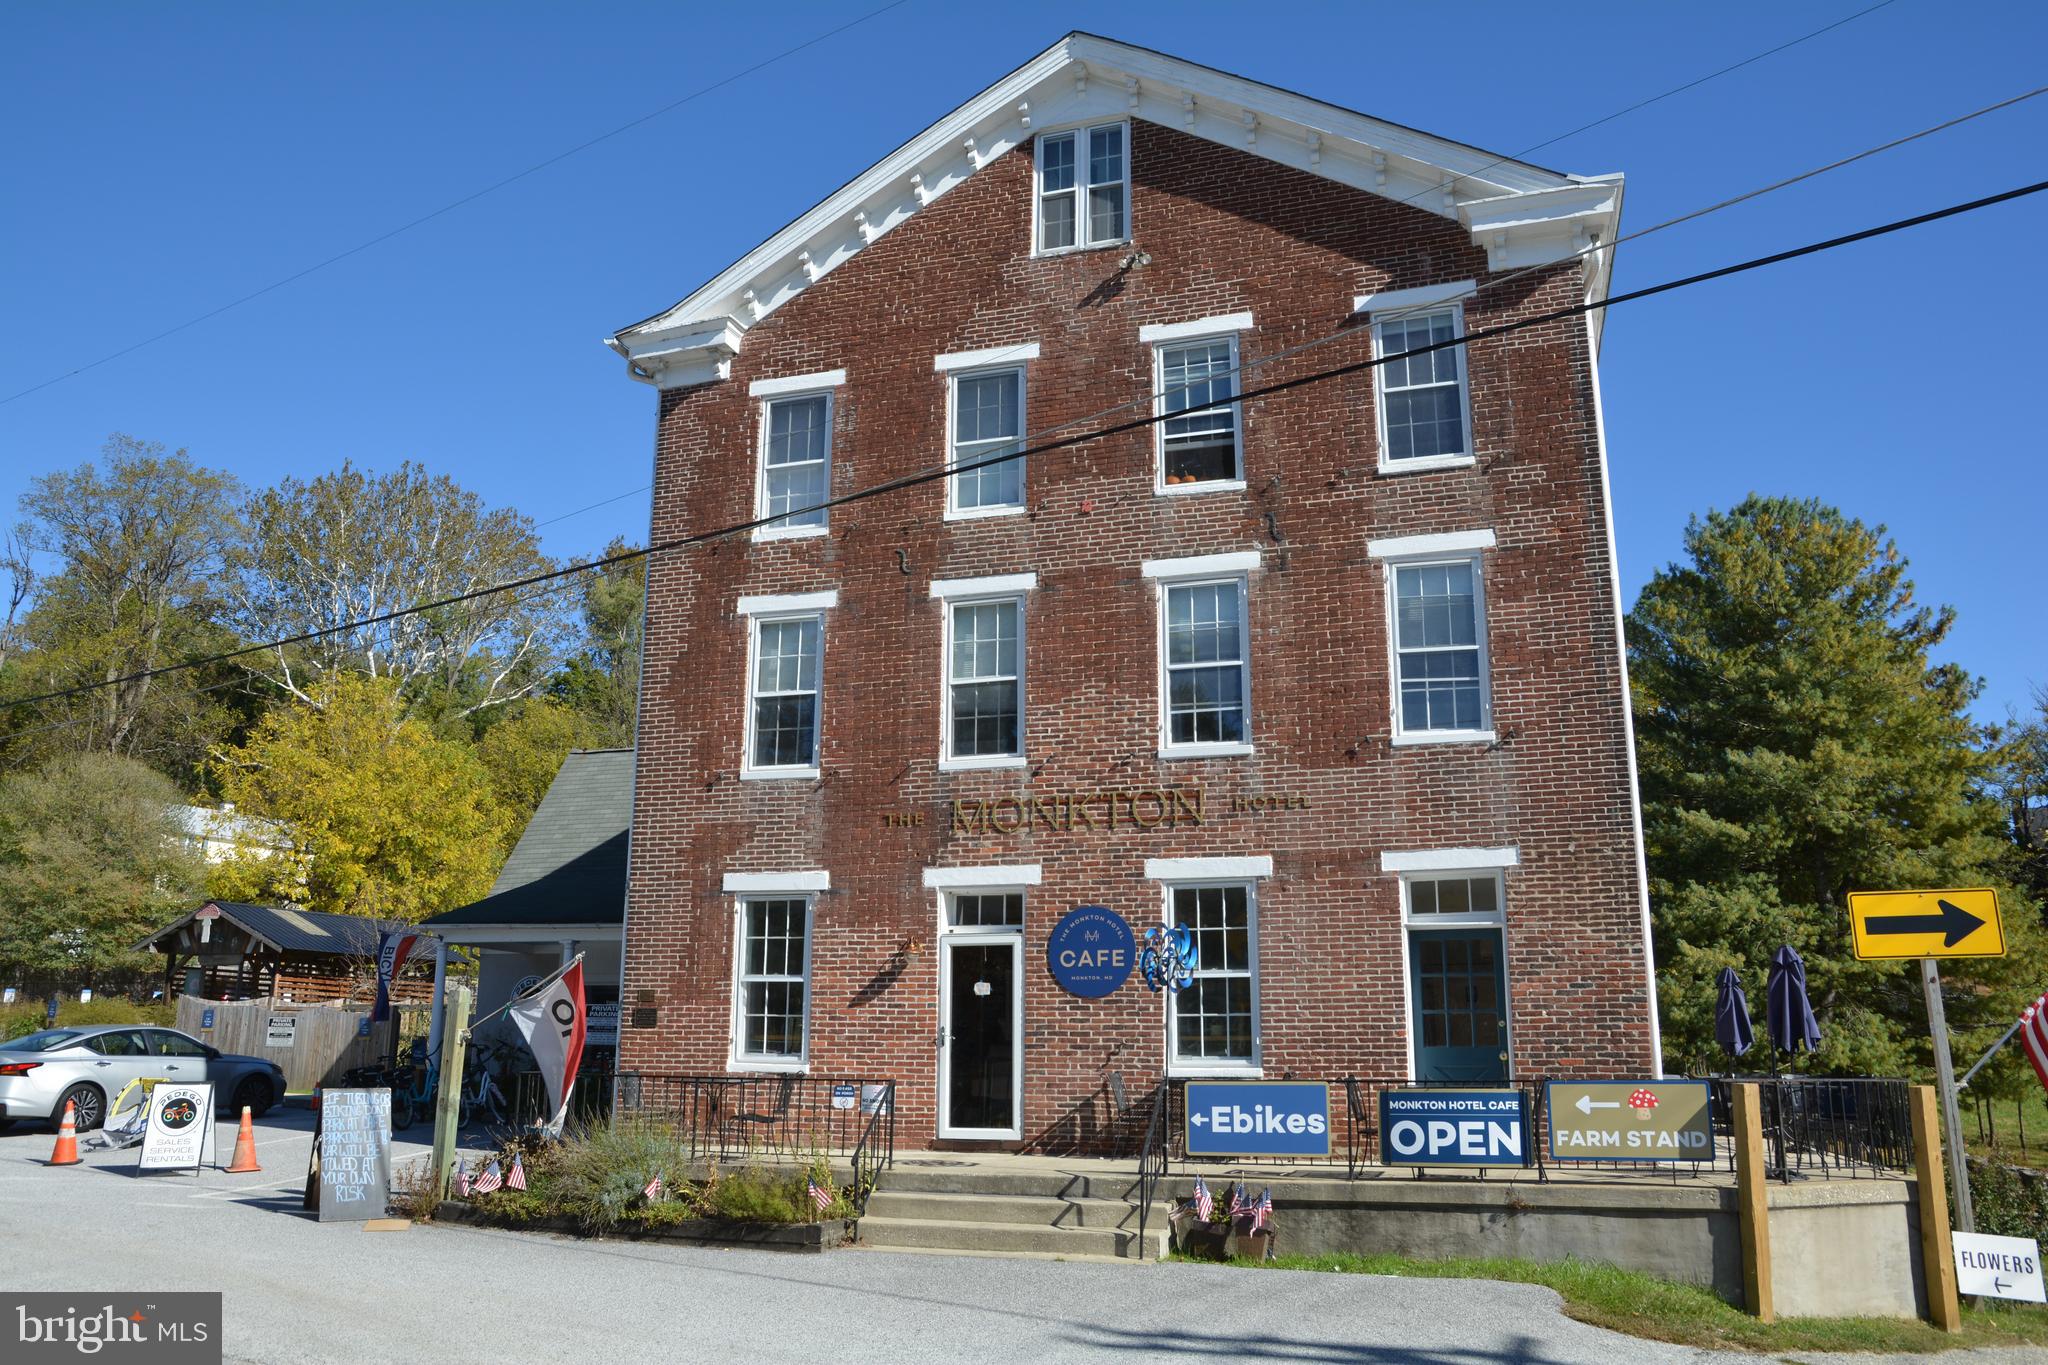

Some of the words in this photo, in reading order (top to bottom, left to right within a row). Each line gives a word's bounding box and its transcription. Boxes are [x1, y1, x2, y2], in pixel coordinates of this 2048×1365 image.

[884, 811, 925, 829] THE
[951, 786, 1206, 836] MONKTON
[1232, 795, 1314, 812] HOTEL
[1060, 928, 1070, 942] THE
[1069, 914, 1105, 929] MONKTON
[1106, 919, 1125, 940] HOTEL
[1059, 949, 1126, 968] CAFE
[160, 1091, 202, 1107] PEDEGO
[323, 1092, 342, 1105] IF
[344, 1092, 379, 1106] TUBING
[380, 1093, 391, 1106] OR
[1389, 1100, 1446, 1110] MONKTON
[1449, 1101, 1486, 1110] HOTEL
[1488, 1101, 1519, 1110] CAFE
[322, 1105, 362, 1118] BIKING
[322, 1117, 346, 1132] PARK
[347, 1117, 360, 1131] AT
[1211, 1104, 1326, 1135] Ebikes
[156, 1137, 191, 1146] SALES
[322, 1130, 362, 1145] PARKING
[1390, 1120, 1522, 1157] OPEN
[1556, 1130, 1621, 1147] FARM
[1626, 1130, 1708, 1148] STAND
[150, 1146, 194, 1154] SERVICE
[322, 1144, 338, 1157] CAR
[339, 1144, 364, 1157] WILL
[366, 1143, 380, 1157] BE
[145, 1155, 195, 1163] RENTALS
[322, 1156, 358, 1171] TOWED
[362, 1156, 376, 1171] AT
[322, 1170, 347, 1185] YOUR
[349, 1170, 375, 1186] OWN
[335, 1184, 366, 1203] RISK
[1961, 1250, 2034, 1275] FLOWERS
